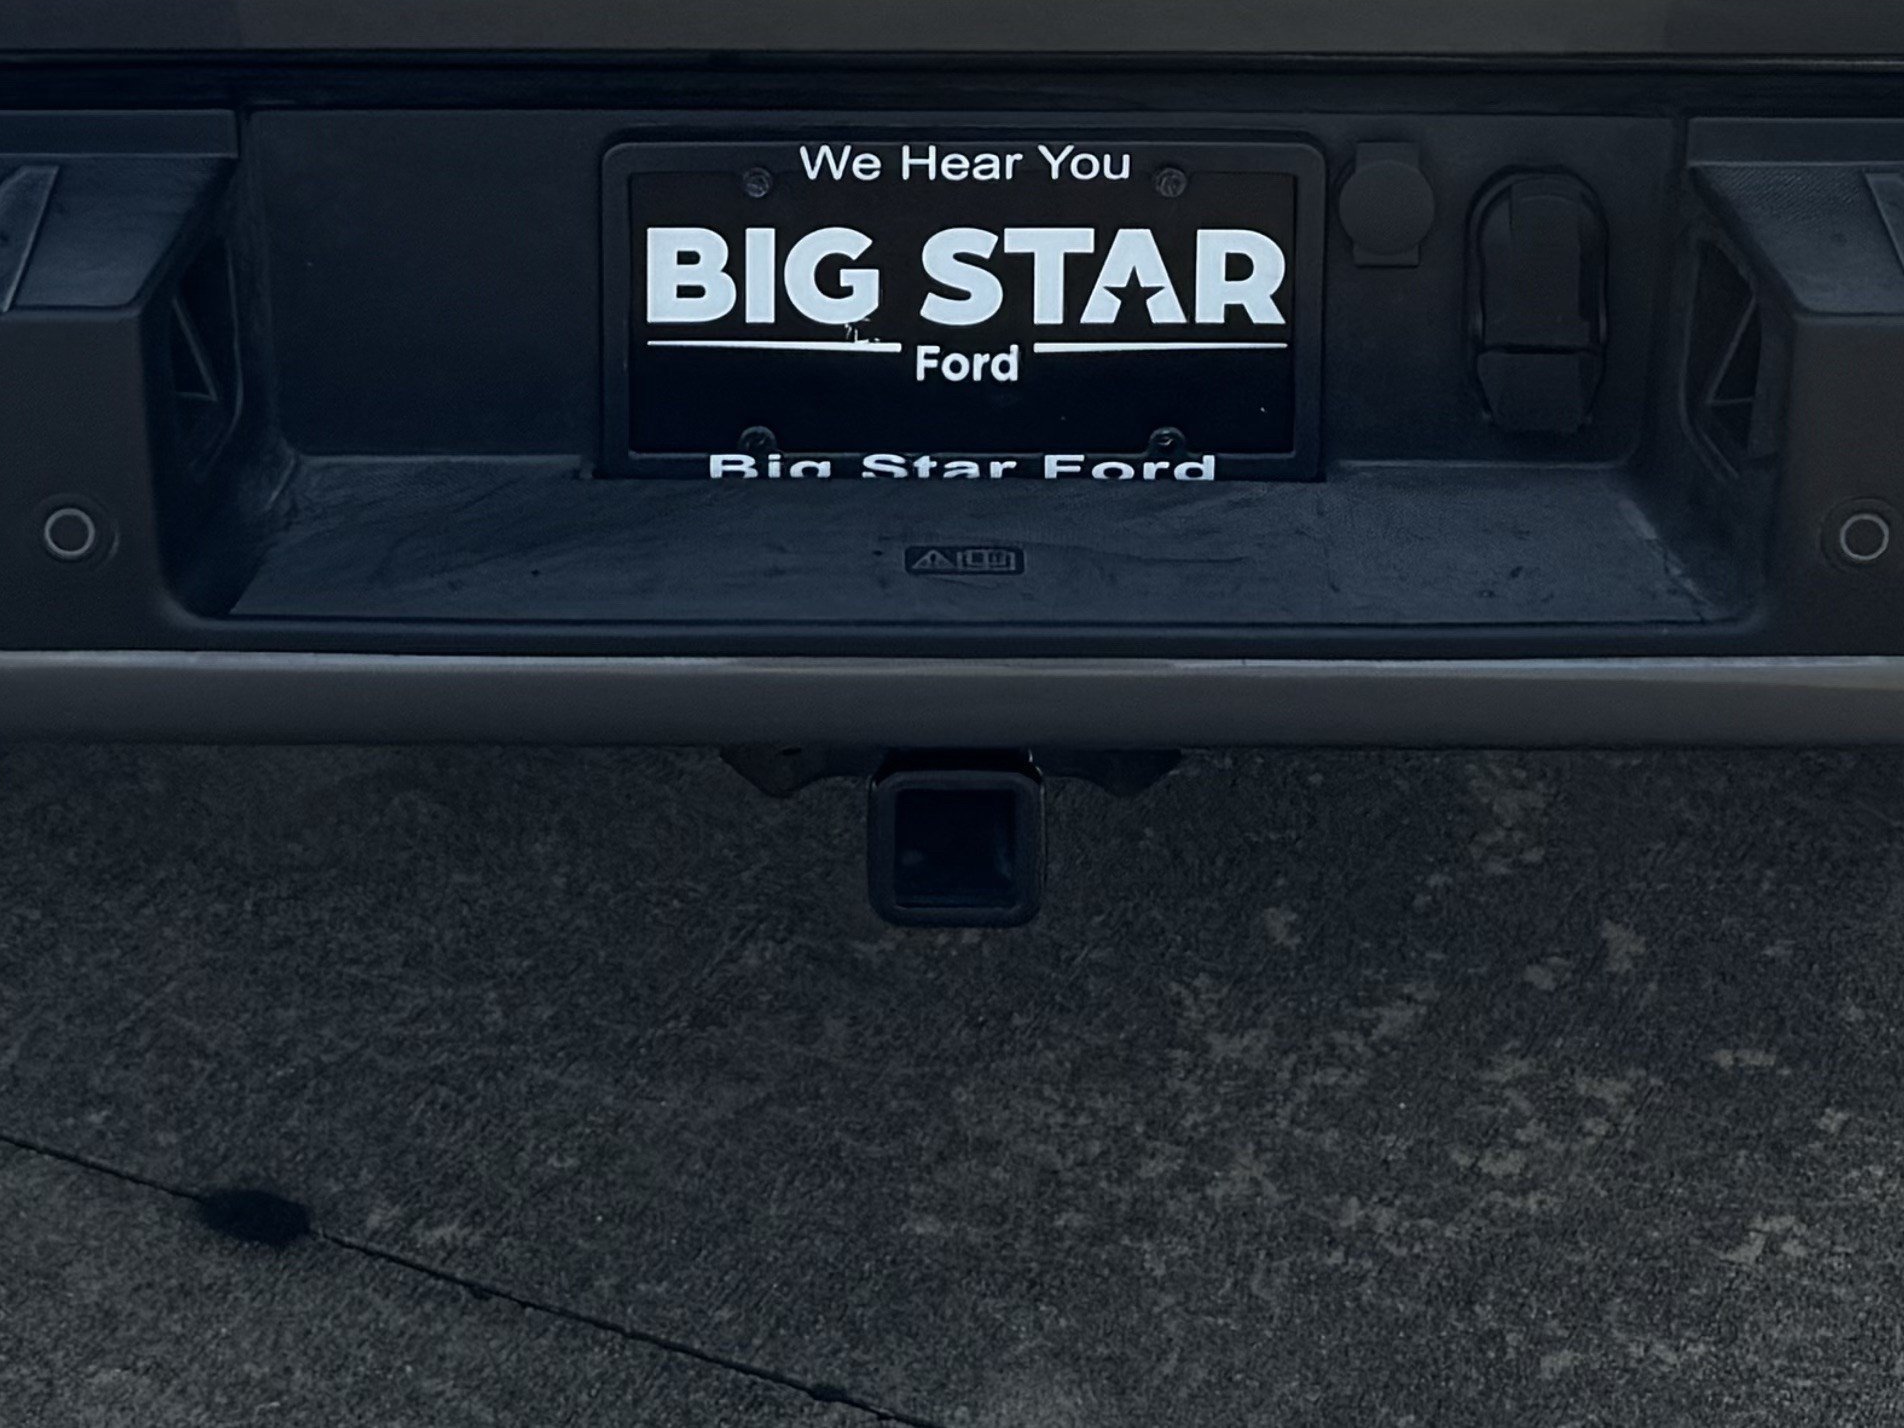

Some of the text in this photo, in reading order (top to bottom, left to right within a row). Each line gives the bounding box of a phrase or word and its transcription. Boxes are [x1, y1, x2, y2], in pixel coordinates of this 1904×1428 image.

[799, 144, 1131, 181] We Hear You
[646, 226, 1286, 326] BIG STAR
[916, 343, 1019, 382] Ford
[861, 453, 1017, 479] Star
[1044, 454, 1216, 481] Ford
